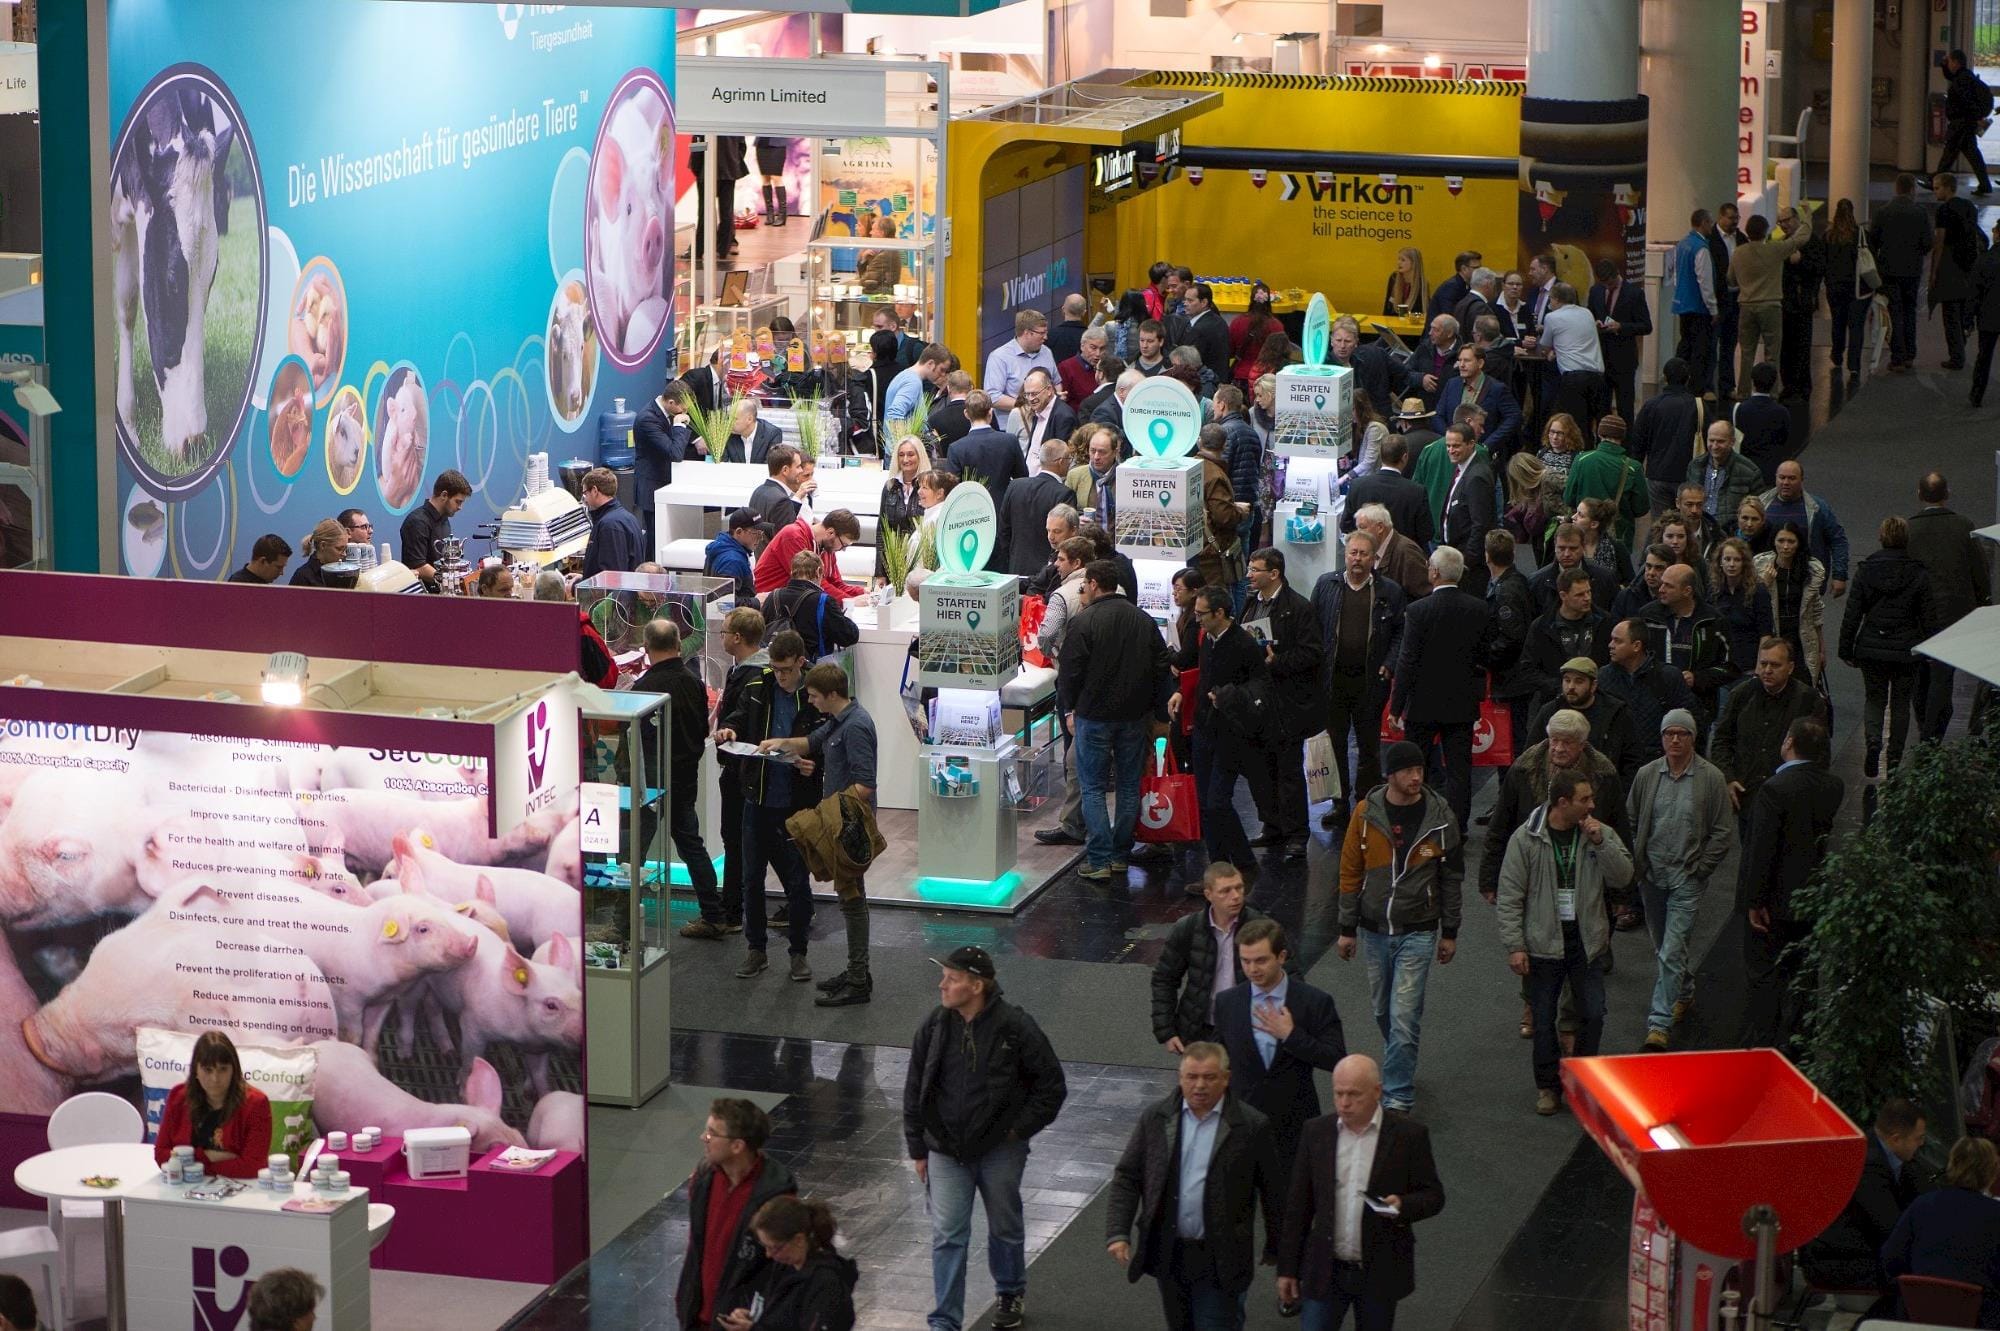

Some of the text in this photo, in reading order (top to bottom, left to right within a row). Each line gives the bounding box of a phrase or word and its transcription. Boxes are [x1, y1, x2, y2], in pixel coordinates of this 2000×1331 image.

[530, 19, 593, 52] Tiergesundheit
[1767, 59, 1774, 68] A
[7, 78, 27, 89] Life
[712, 87, 827, 104] Agrimn Limited
[1737, 10, 1759, 184] Bimeda
[288, 166, 316, 208] Die
[320, 131, 434, 199] Wissenschaft
[436, 127, 459, 168] für
[462, 109, 540, 170] gesündere
[841, 160, 893, 168] AGRIMIN
[1103, 150, 1136, 182] Virkon
[1313, 206, 1412, 222] the science to
[1313, 222, 1412, 242] kill pathogens
[1010, 273, 1043, 307] Virkon
[1290, 384, 1330, 394] STARTEN
[1290, 394, 1311, 402] HIER
[1130, 407, 1191, 418] DURCH FORSCHUNG
[1132, 480, 1176, 489] STARTEN
[1132, 490, 1154, 499] HIER
[937, 597, 986, 609] STARTEN
[937, 610, 962, 620] HIER
[0, 718, 142, 750] onfortDry
[190, 733, 251, 748] Absorbing
[0, 751, 130, 773] 00% Absorption Capacity
[232, 752, 283, 763] powders
[168, 781, 226, 794] Bactericidal
[235, 786, 293, 799] Disinfectant
[295, 792, 349, 804] properties.
[384, 777, 413, 791] 100%
[414, 780, 476, 796] Absorption
[525, 786, 557, 817] INTEC
[190, 809, 329, 828] Improve sanitary conditions.
[585, 808, 601, 826] A
[168, 833, 184, 844] For
[187, 835, 202, 845] the
[204, 836, 235, 848] health
[238, 839, 255, 849] and
[258, 841, 293, 852] welfare
[296, 843, 306, 852] of
[172, 860, 347, 881] Reduces pre-weaning mortality rate.
[216, 888, 303, 904] Prevent diseases.
[169, 911, 352, 934] Disinfects, cure and treat the wounds.
[215, 940, 306, 956] Decrease diarrhea.
[175, 963, 348, 986] Prevent the proliferation of insects.
[192, 990, 332, 1010] Reduce ammonia emissions.
[189, 1015, 337, 1037] Decreased spending on drugs.
